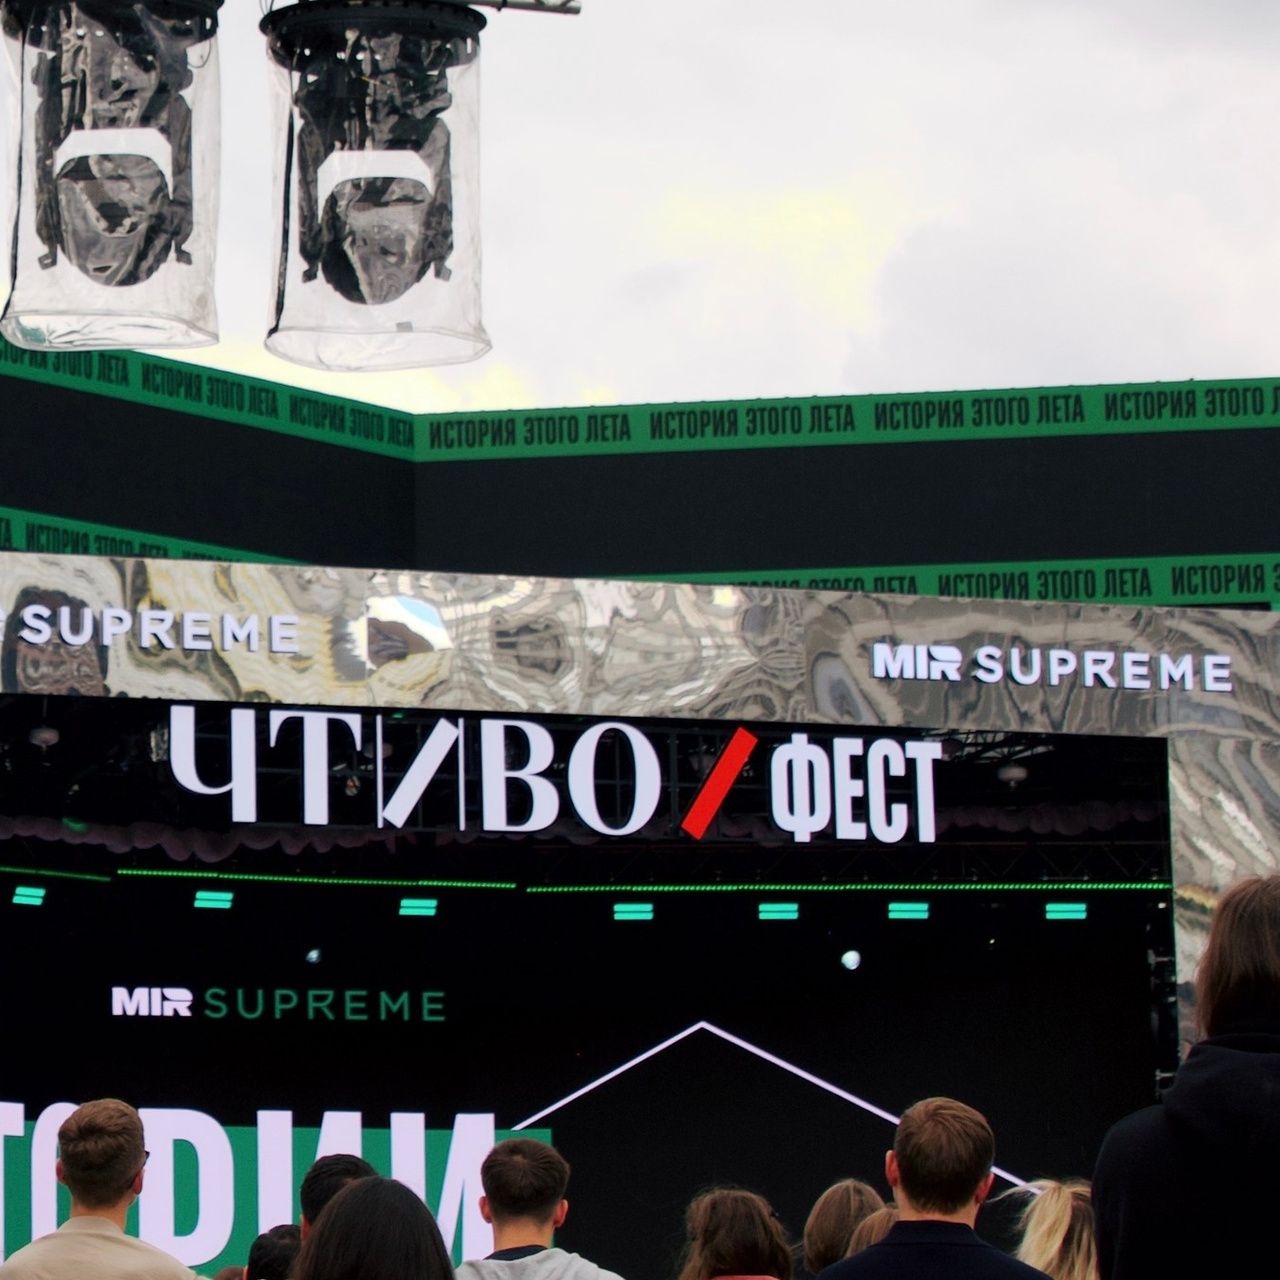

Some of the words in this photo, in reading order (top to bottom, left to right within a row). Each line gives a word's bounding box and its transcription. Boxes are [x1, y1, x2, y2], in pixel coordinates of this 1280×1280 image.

[97, 352, 129, 387] ЛЕТА
[141, 361, 202, 403] ИСТОРИЯ
[206, 376, 245, 412] ЭТОГО
[249, 385, 279, 420] ЛЕТА
[1104, 389, 1197, 422] ИСТОРИЯ
[1205, 386, 1265, 417] ЭТОГО
[290, 394, 345, 434] ИСТОРИЯ
[349, 407, 385, 443] ЭТОГО
[387, 417, 415, 449] ЛЕТА
[649, 408, 739, 441] ИСТОРИЯ
[745, 405, 802, 436] ЭТОГО
[808, 403, 856, 434] ЛЕТА
[874, 398, 965, 431] ИСТОРИЯ
[971, 395, 1030, 427] ЭТОГО
[1036, 393, 1086, 424] ЛЕТА
[429, 418, 516, 450] ИСТОРИЯ
[523, 416, 579, 447] ЭТОГО
[585, 413, 631, 443] ЛЕТА
[25, 522, 90, 554] ИСТОРИЯ
[937, 571, 1030, 600] ИСТОРИЯ
[1036, 569, 1096, 600] ЭТОГО
[1103, 567, 1153, 598] ЛЕТА
[1171, 563, 1266, 596] ИСТОРИЯ
[18, 602, 300, 654] SUPREME
[872, 642, 963, 682] MIR
[973, 645, 1233, 692] SUPREME
[168, 705, 662, 838] ЧТИВО
[769, 732, 944, 844] ФЕСТ
[111, 986, 194, 1017] MIR
[203, 987, 446, 1022] SUPREME
